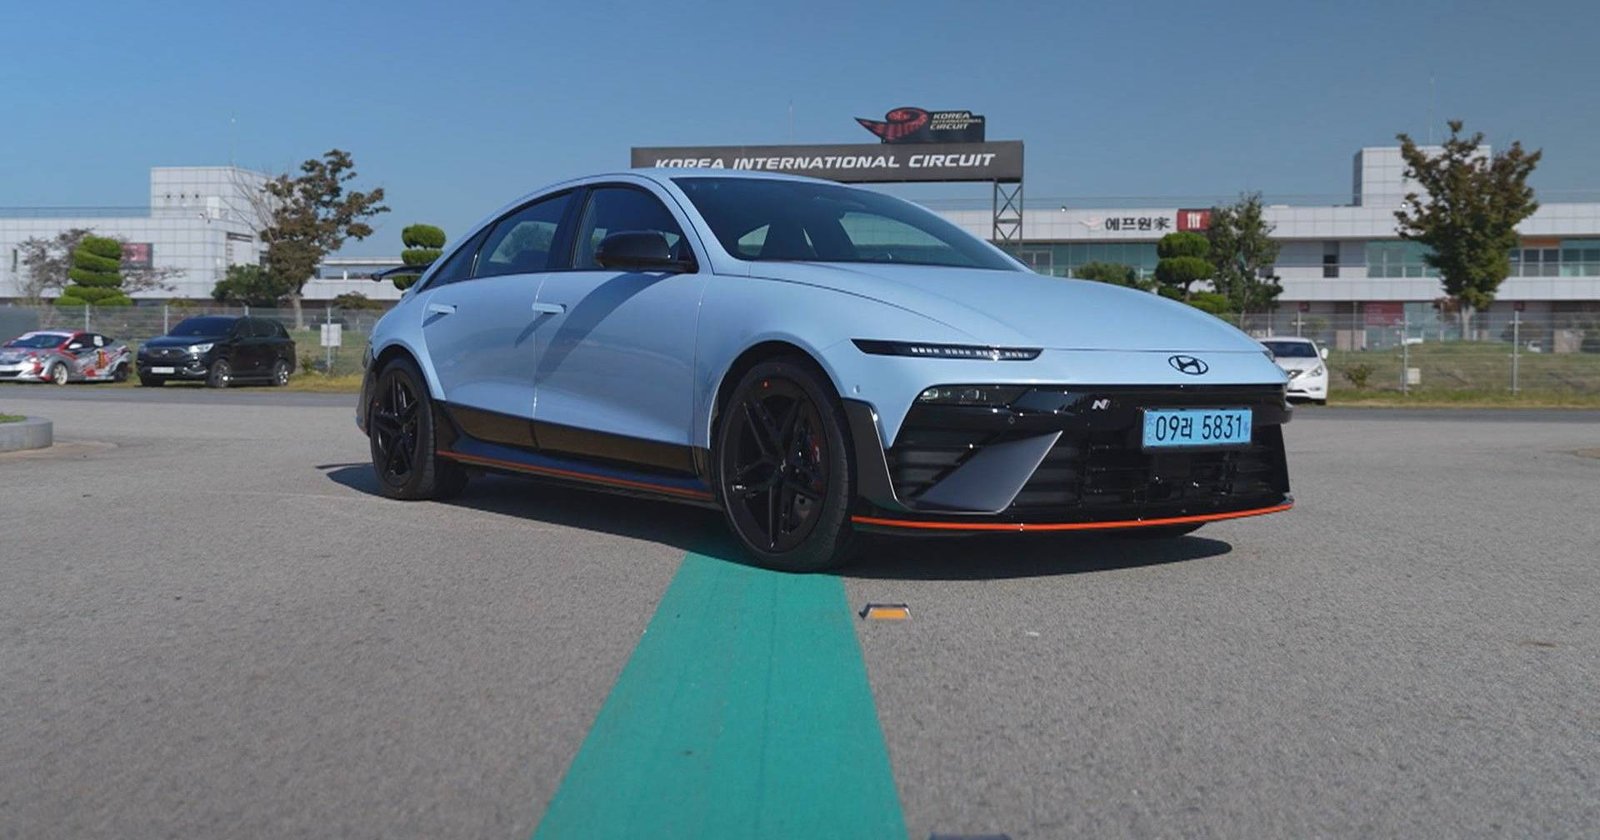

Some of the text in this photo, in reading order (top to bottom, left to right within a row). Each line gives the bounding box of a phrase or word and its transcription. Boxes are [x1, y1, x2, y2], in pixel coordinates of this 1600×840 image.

[655, 153, 996, 170] KOREA INTERNATIONAL CIRCUIT
[1202, 415, 1242, 440] 5831
